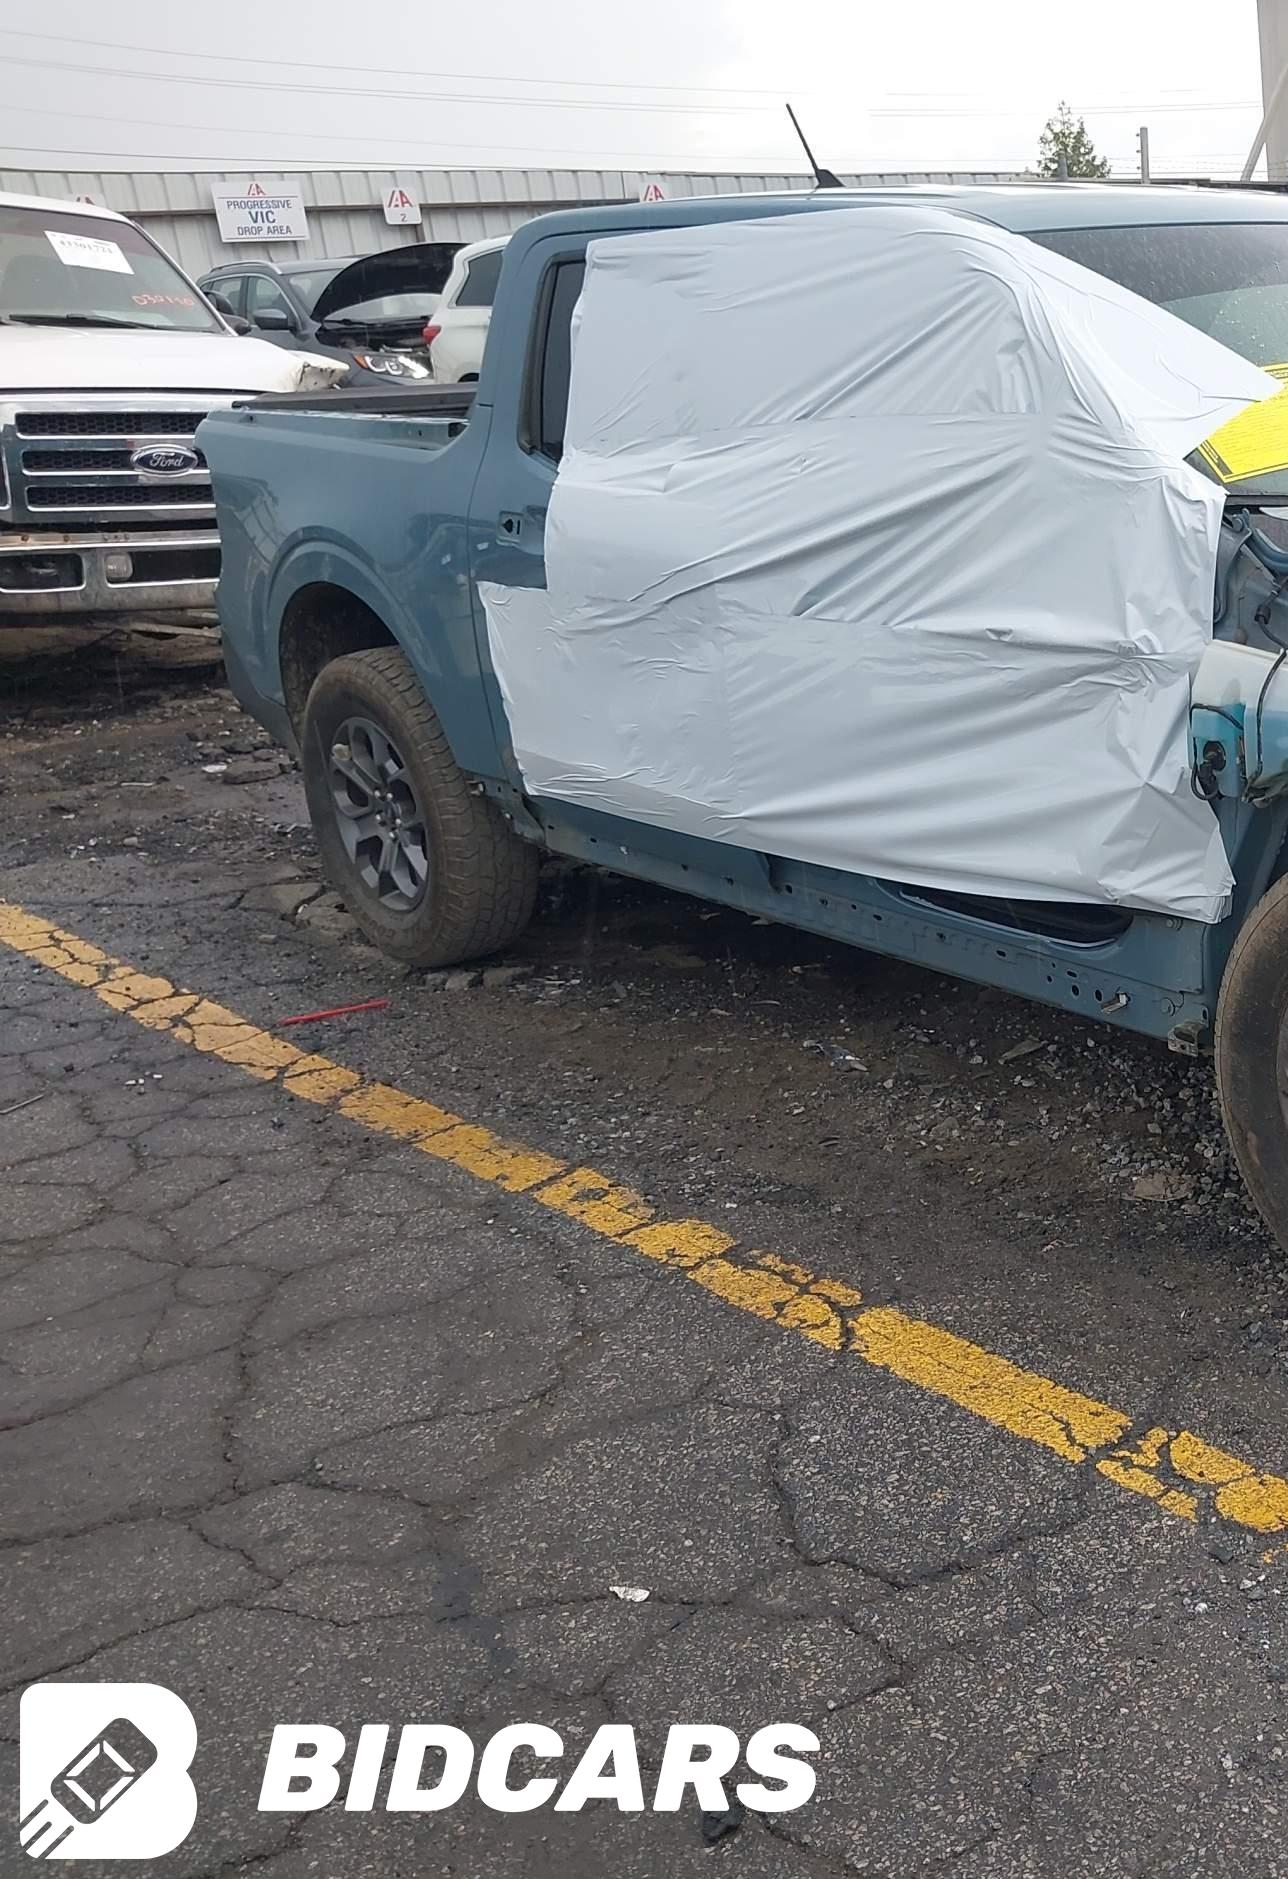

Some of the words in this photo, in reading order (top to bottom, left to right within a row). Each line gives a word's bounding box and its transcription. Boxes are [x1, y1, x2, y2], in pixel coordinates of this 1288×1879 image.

[226, 199, 292, 209] PROGRESSIVE
[248, 210, 276, 224] VIC
[400, 213, 407, 222] 2
[237, 226, 263, 236] DROP
[266, 225, 292, 235] AREA
[149, 452, 185, 467] Ford
